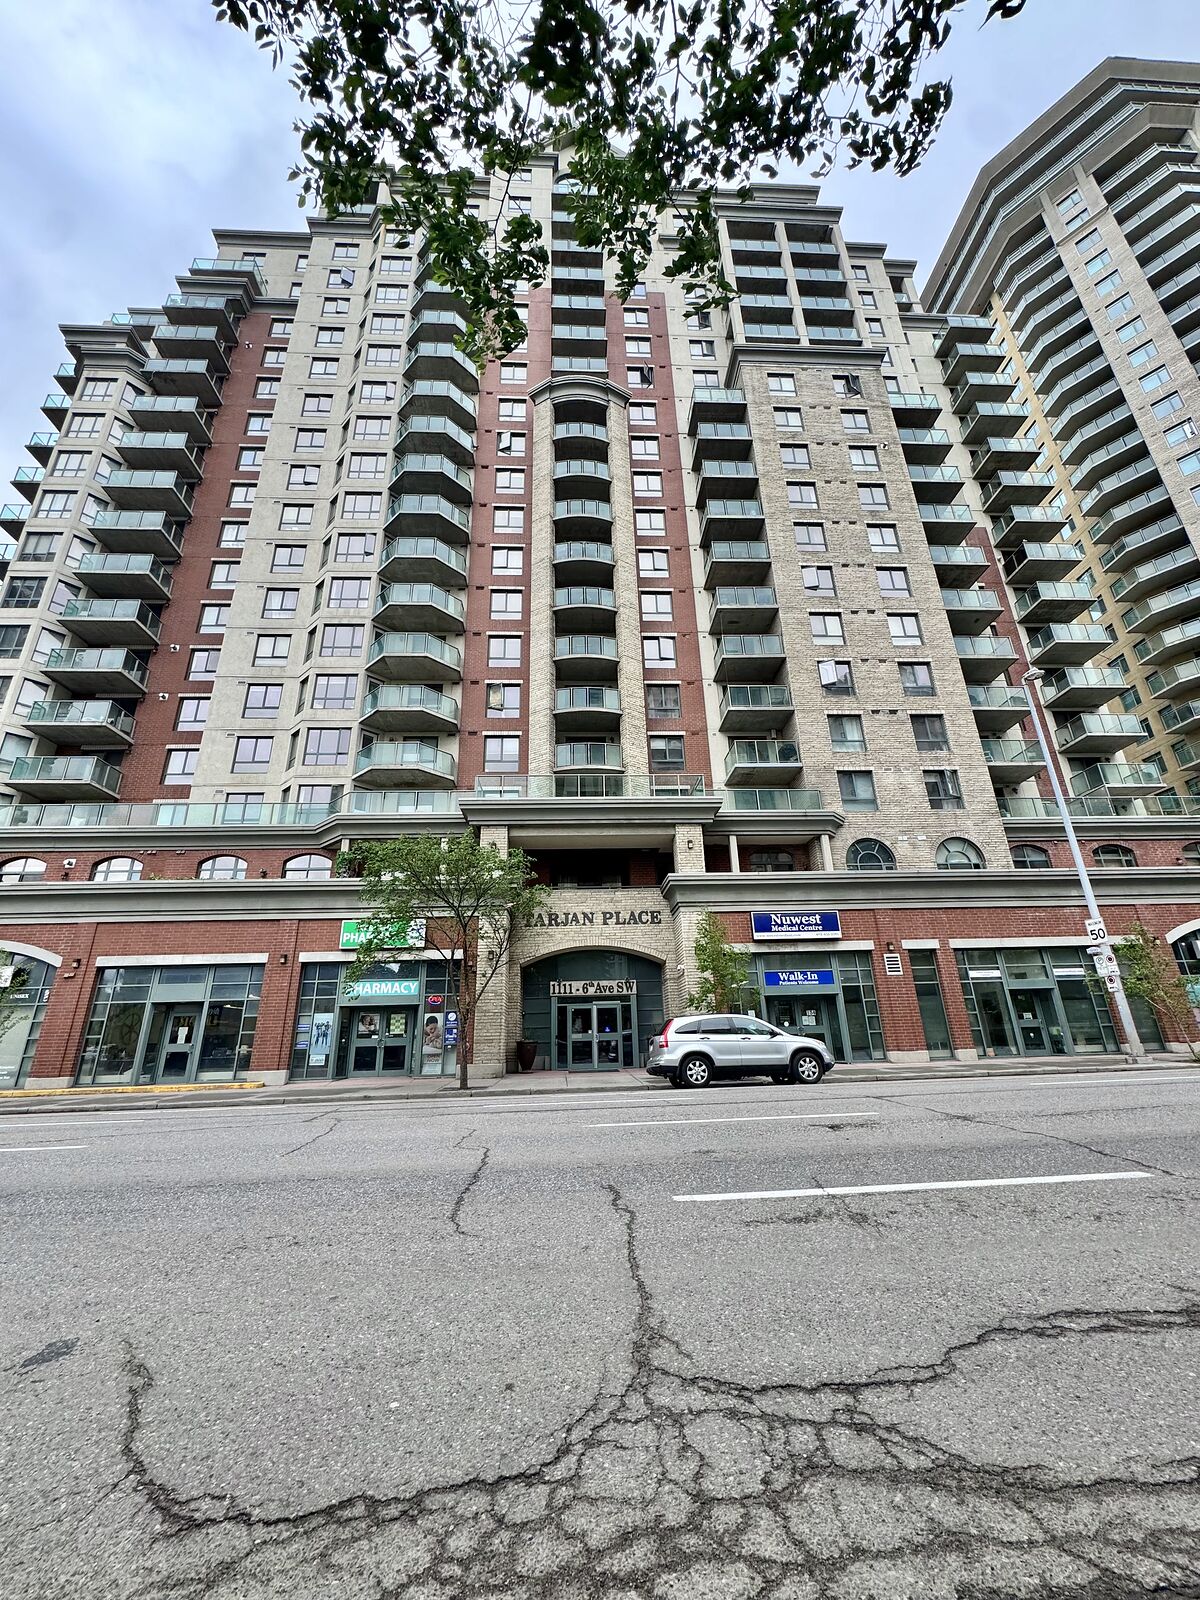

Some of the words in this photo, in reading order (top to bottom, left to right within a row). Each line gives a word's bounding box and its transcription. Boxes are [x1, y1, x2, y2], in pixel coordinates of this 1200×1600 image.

[602, 911, 661, 925] PLACE
[770, 914, 821, 924] Nuwest
[1090, 928, 1105, 940] 50
[778, 972, 818, 980] Walk-In
[551, 982, 573, 995] 1111
[594, 981, 614, 994] Ave
[616, 981, 635, 993] SW
